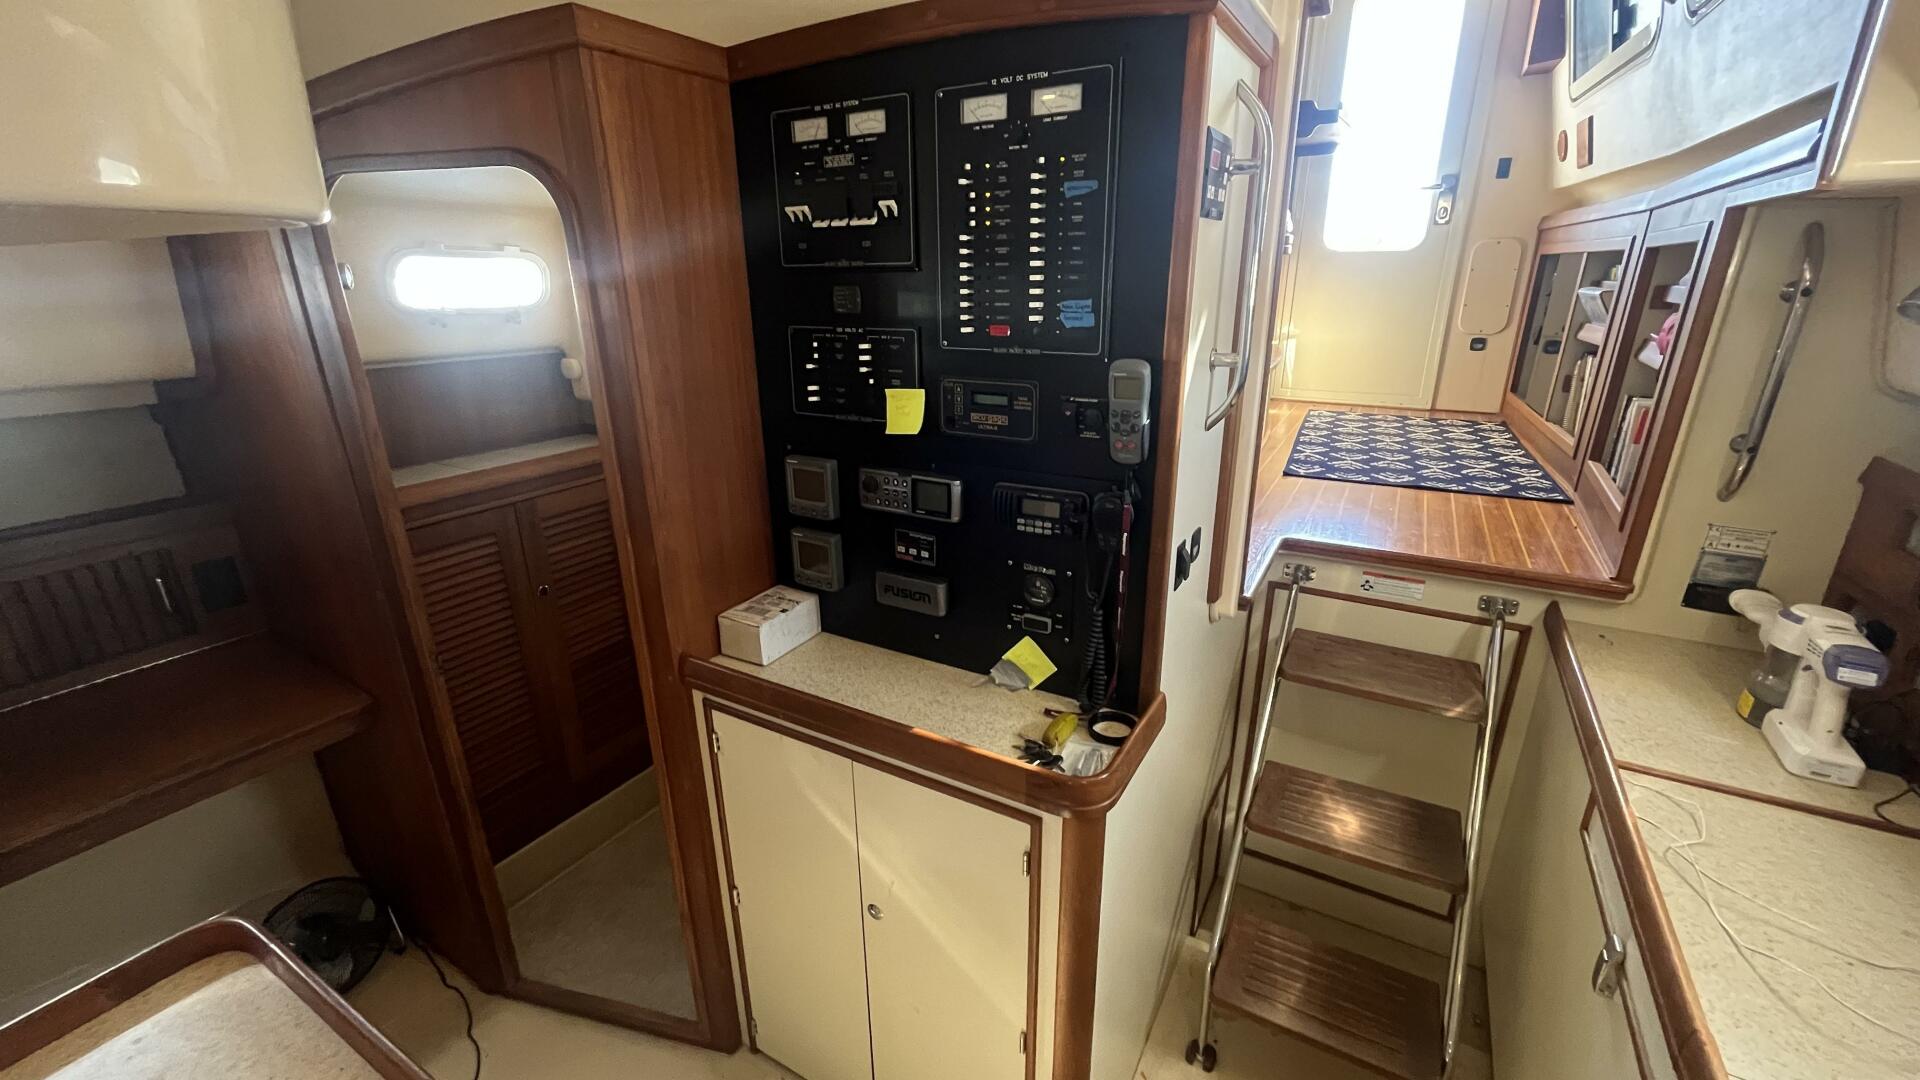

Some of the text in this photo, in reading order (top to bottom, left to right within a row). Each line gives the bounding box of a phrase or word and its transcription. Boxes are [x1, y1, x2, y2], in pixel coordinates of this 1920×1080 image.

[1016, 74, 1023, 82] DC
[1027, 71, 1049, 80] SYSTEM
[843, 99, 859, 107] SYSTEM
[884, 584, 932, 605] FUSION
